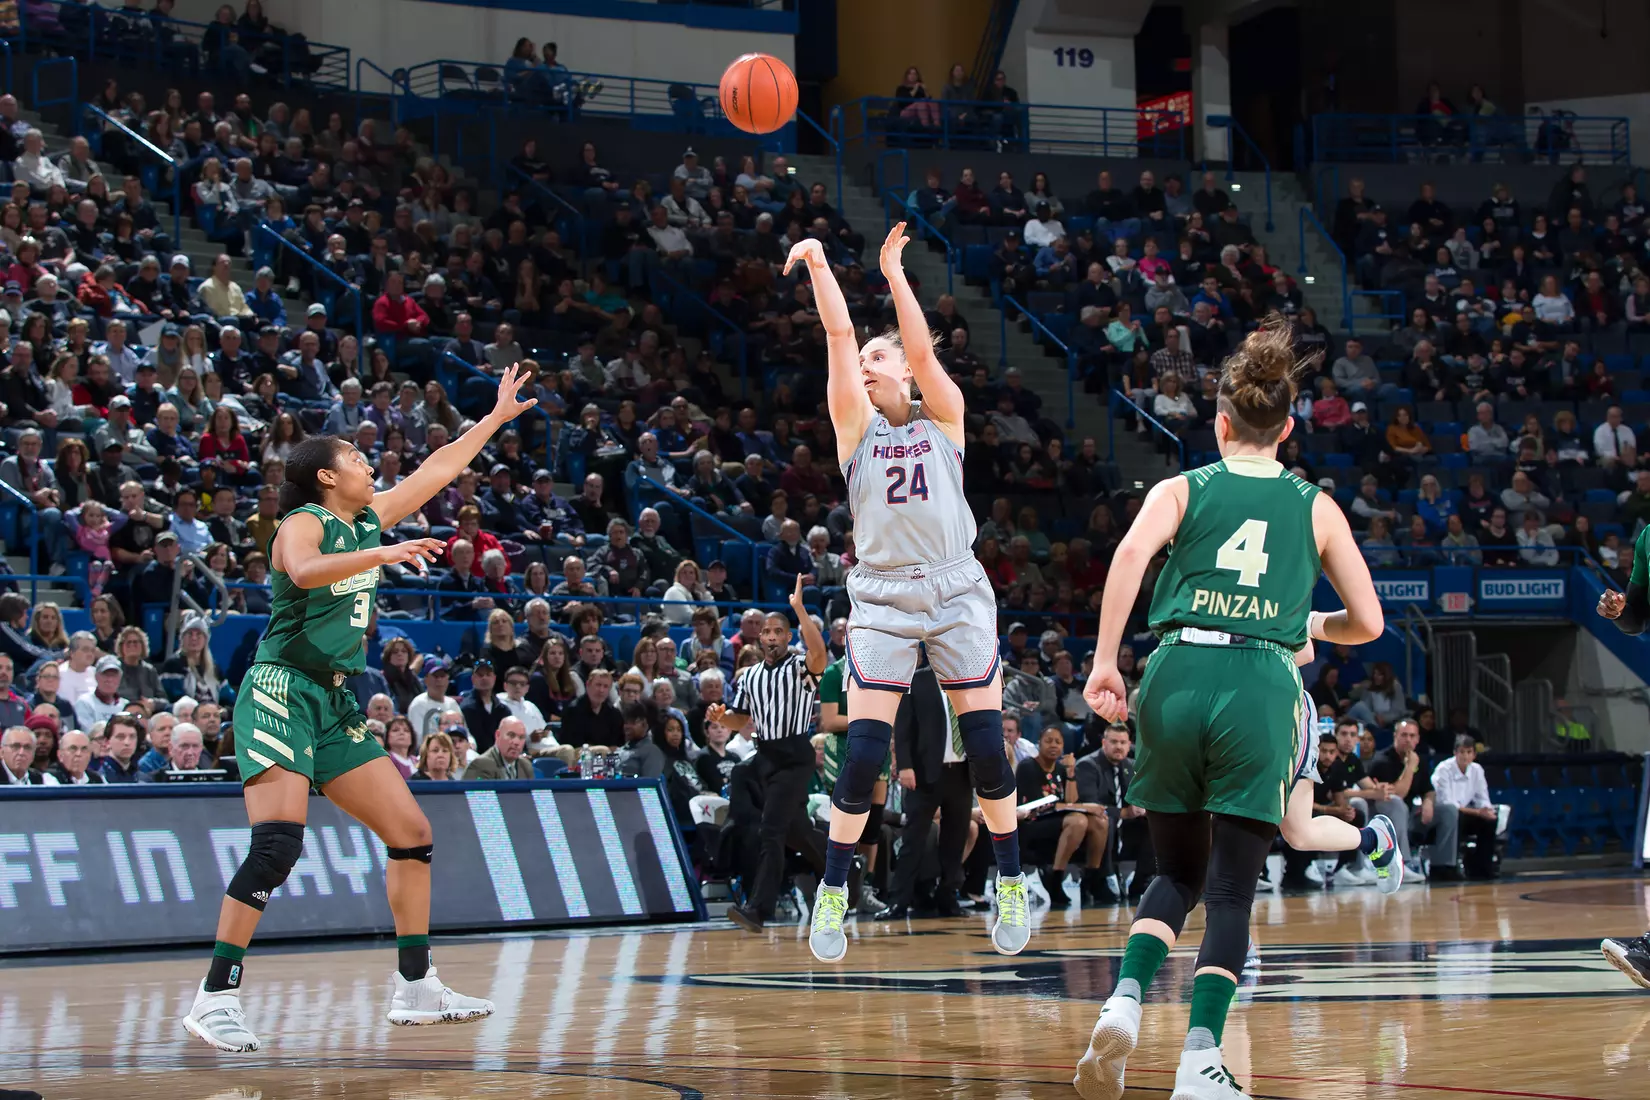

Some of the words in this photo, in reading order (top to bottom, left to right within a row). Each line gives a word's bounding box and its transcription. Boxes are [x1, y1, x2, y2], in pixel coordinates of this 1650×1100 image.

[1053, 47, 1095, 68] 119
[872, 439, 933, 460] HUSKES
[885, 462, 929, 505] 24
[1216, 518, 1269, 588] 4
[1380, 583, 1425, 598] LIGHT
[1484, 583, 1515, 596] BUD
[1518, 582, 1561, 595] LIGHT
[349, 592, 370, 629] 3
[1191, 589, 1279, 620] PINZAN
[1218, 633, 1225, 641] S
